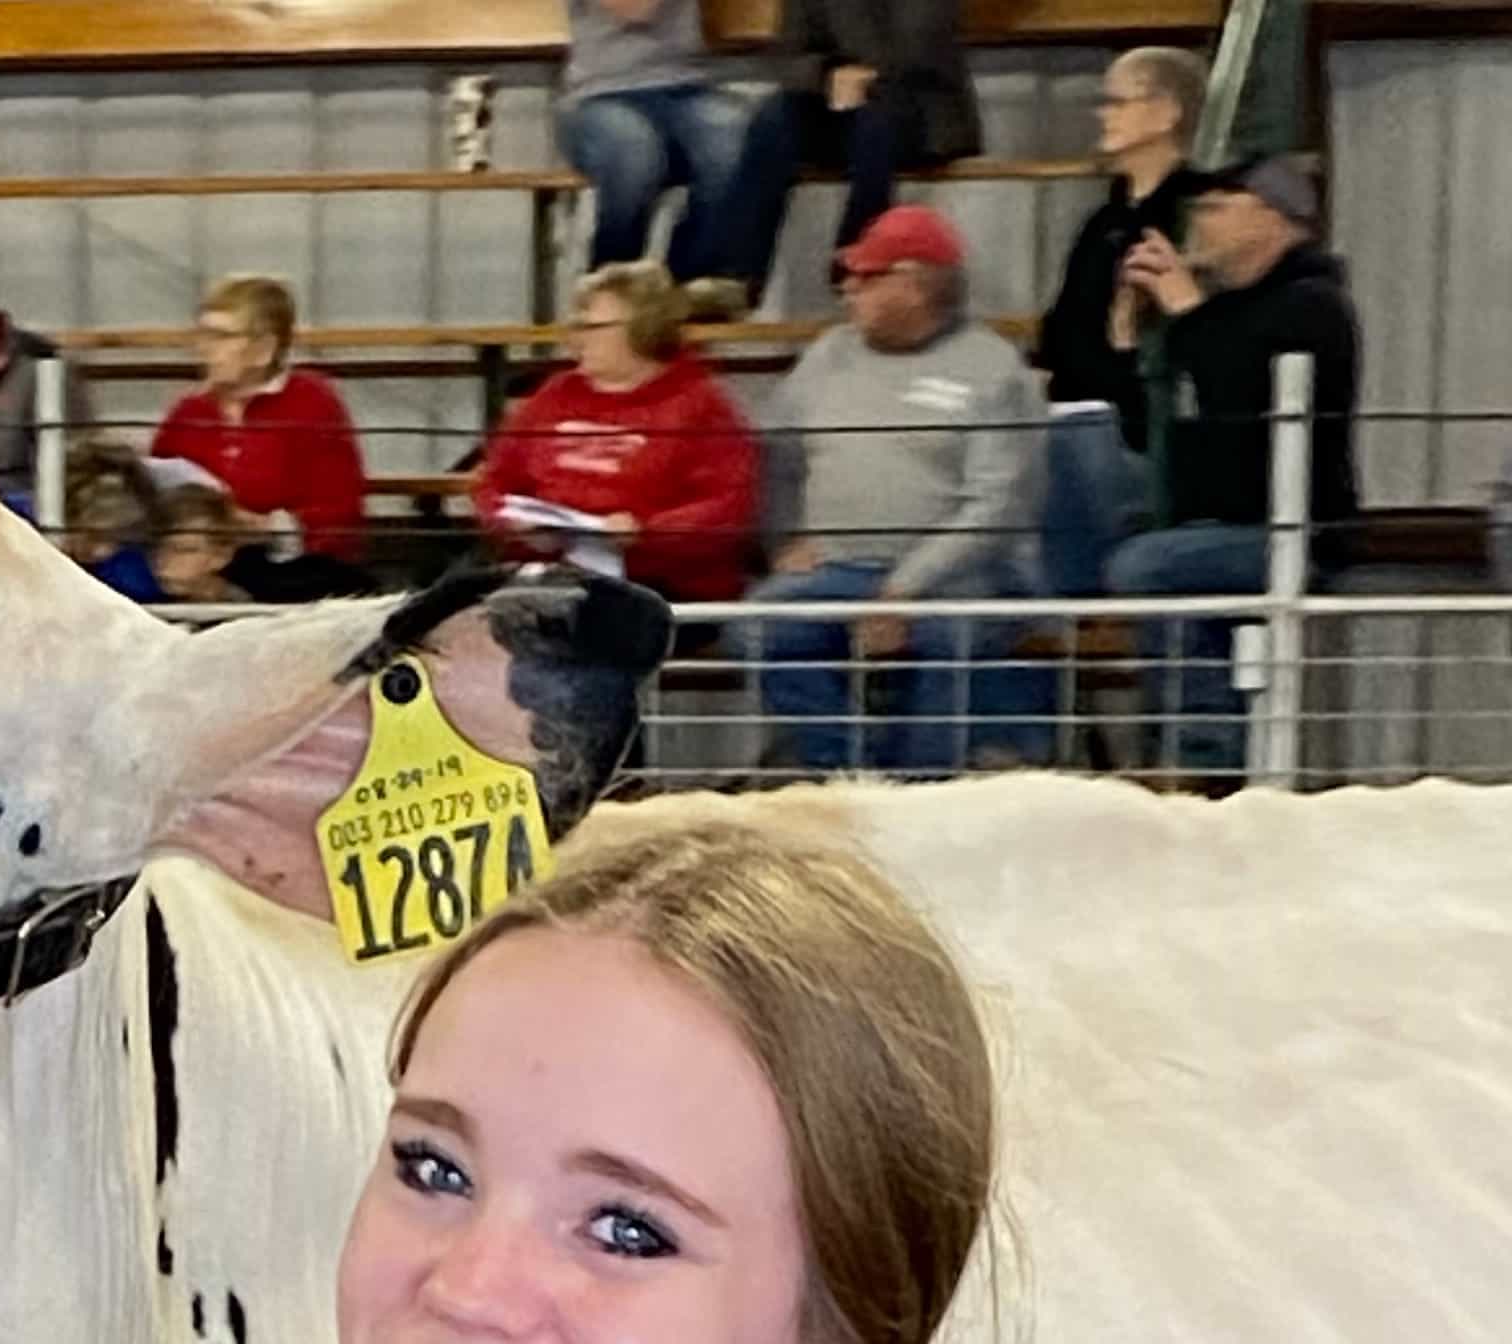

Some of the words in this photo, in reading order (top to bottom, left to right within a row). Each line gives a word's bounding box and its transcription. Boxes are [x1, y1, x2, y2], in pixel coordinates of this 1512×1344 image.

[328, 814, 373, 850] 003
[379, 802, 425, 838] 210
[431, 790, 475, 825] 279
